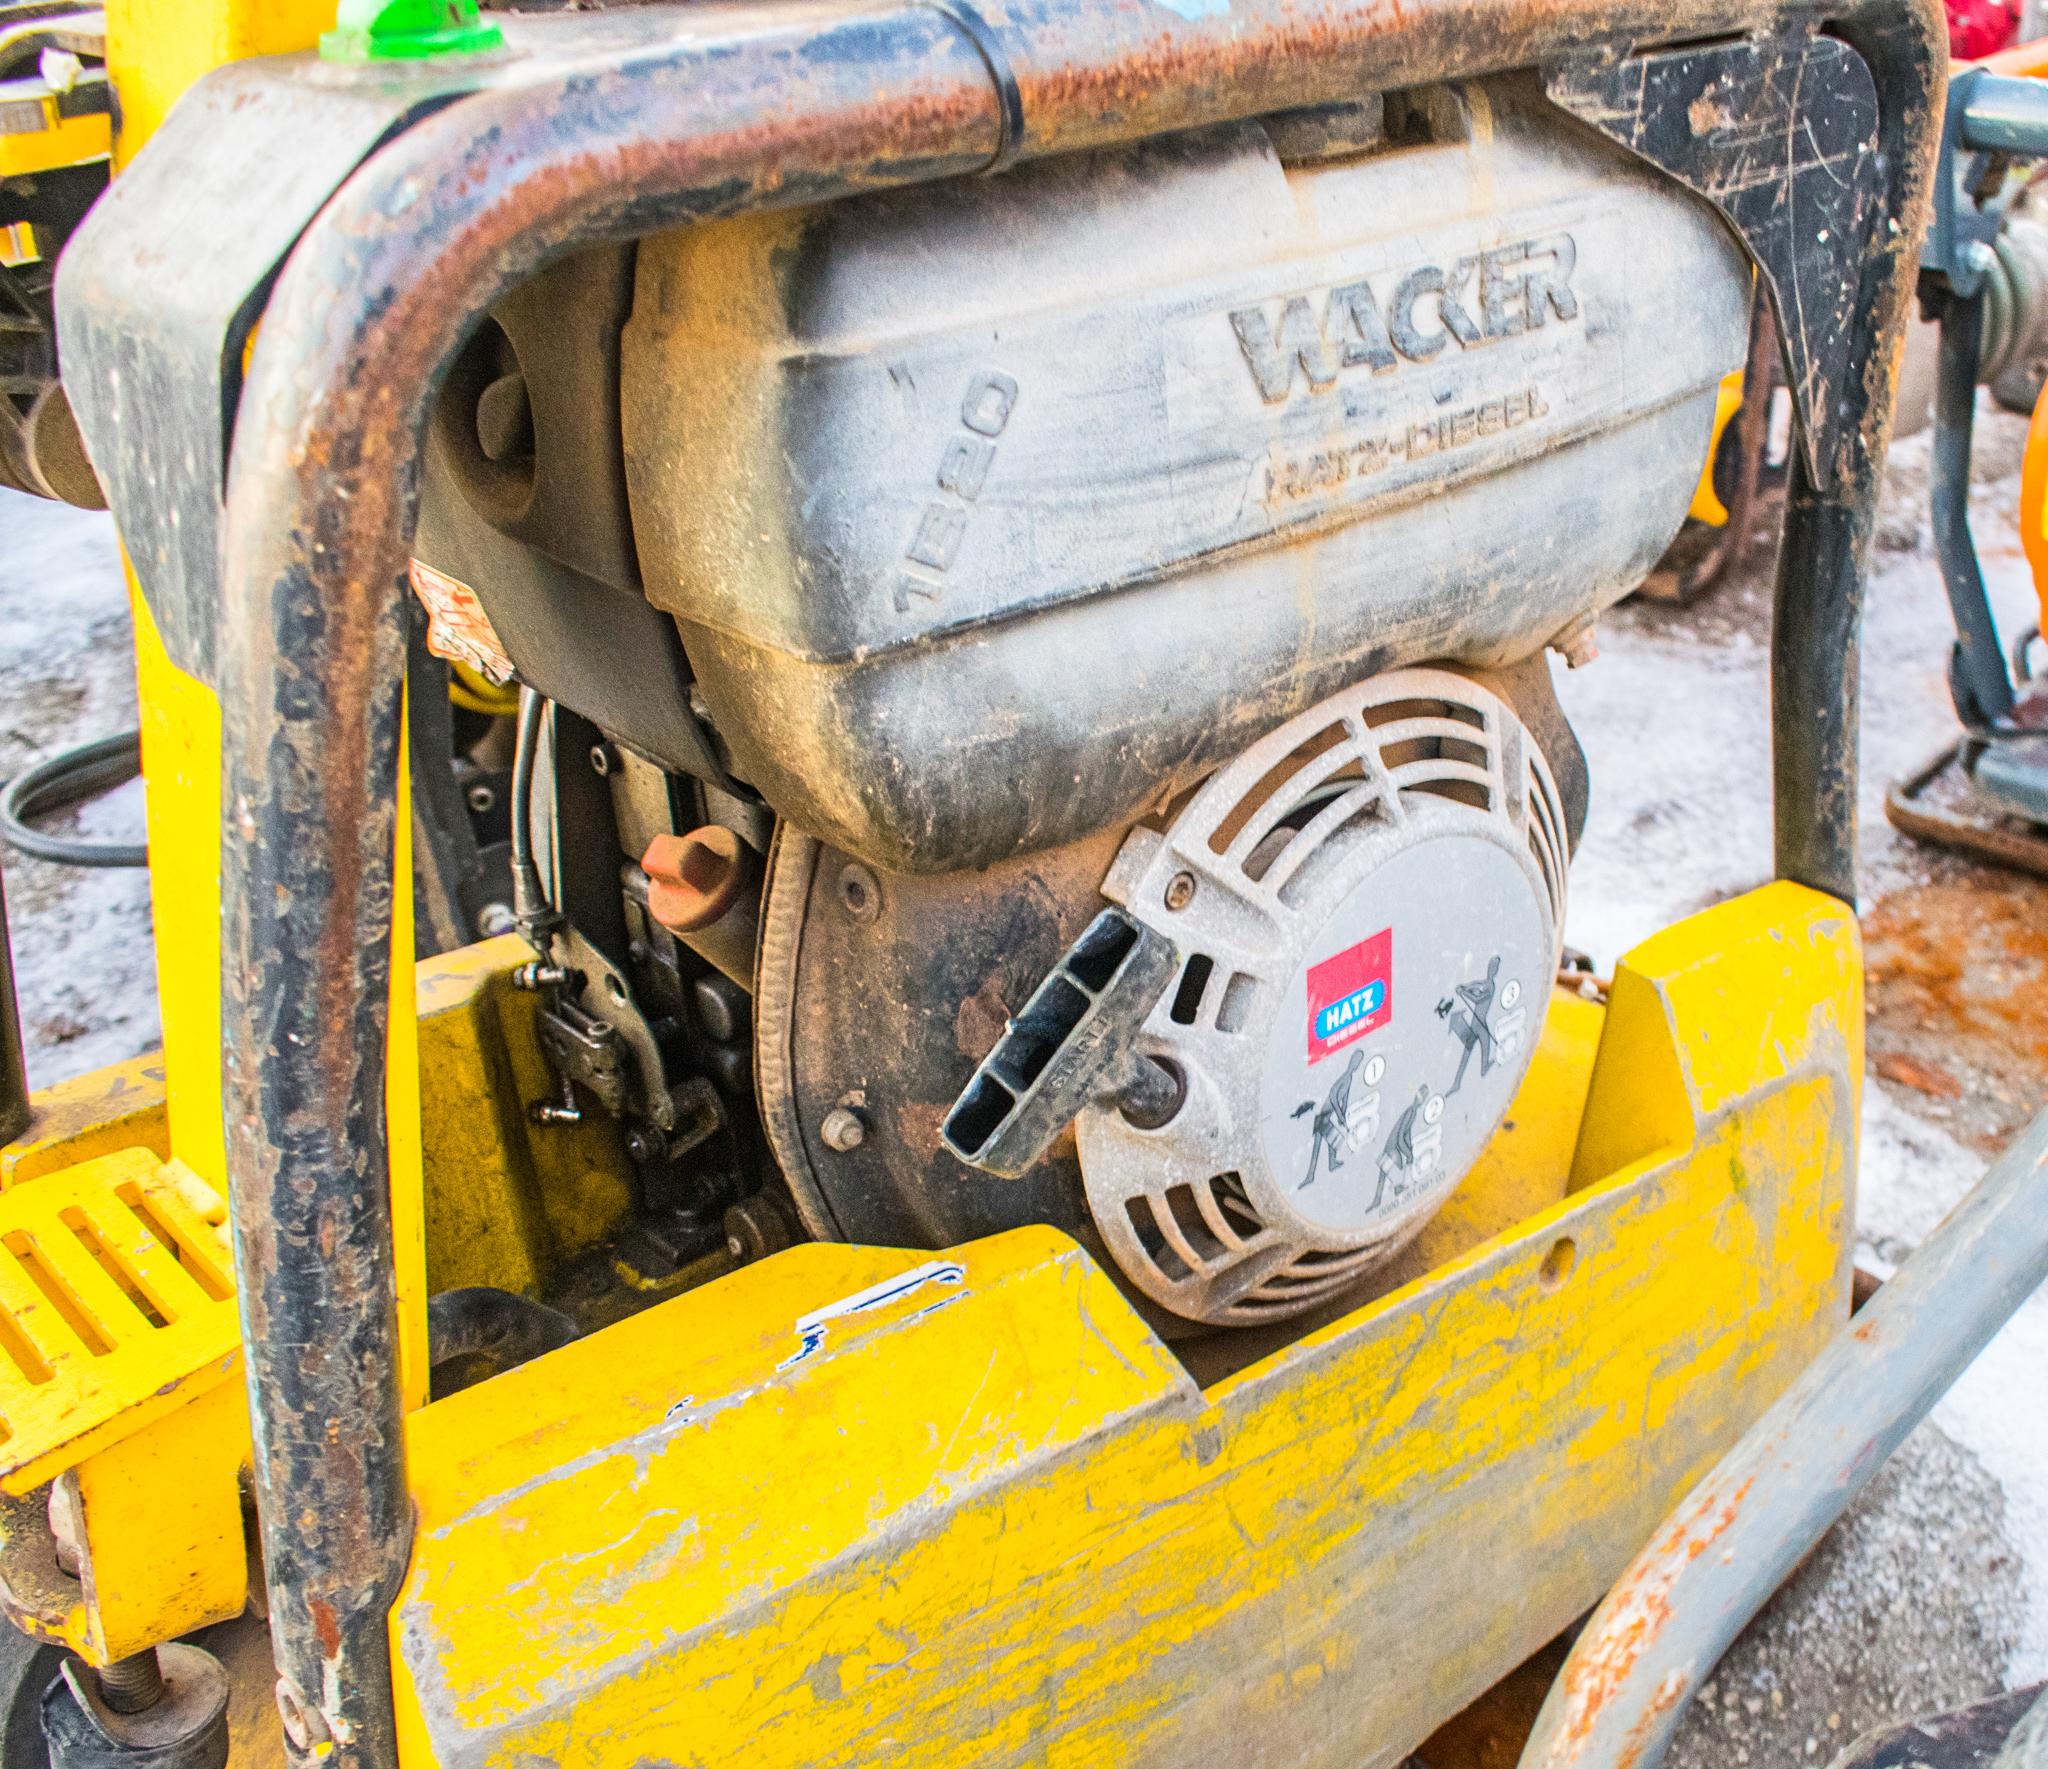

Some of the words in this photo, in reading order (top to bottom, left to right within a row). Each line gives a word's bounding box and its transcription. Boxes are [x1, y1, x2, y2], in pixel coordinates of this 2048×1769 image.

[1228, 232, 1578, 404] WACKER
[1326, 987, 1375, 1032] HATZ
[1326, 1015, 1375, 1048] DIESEL
